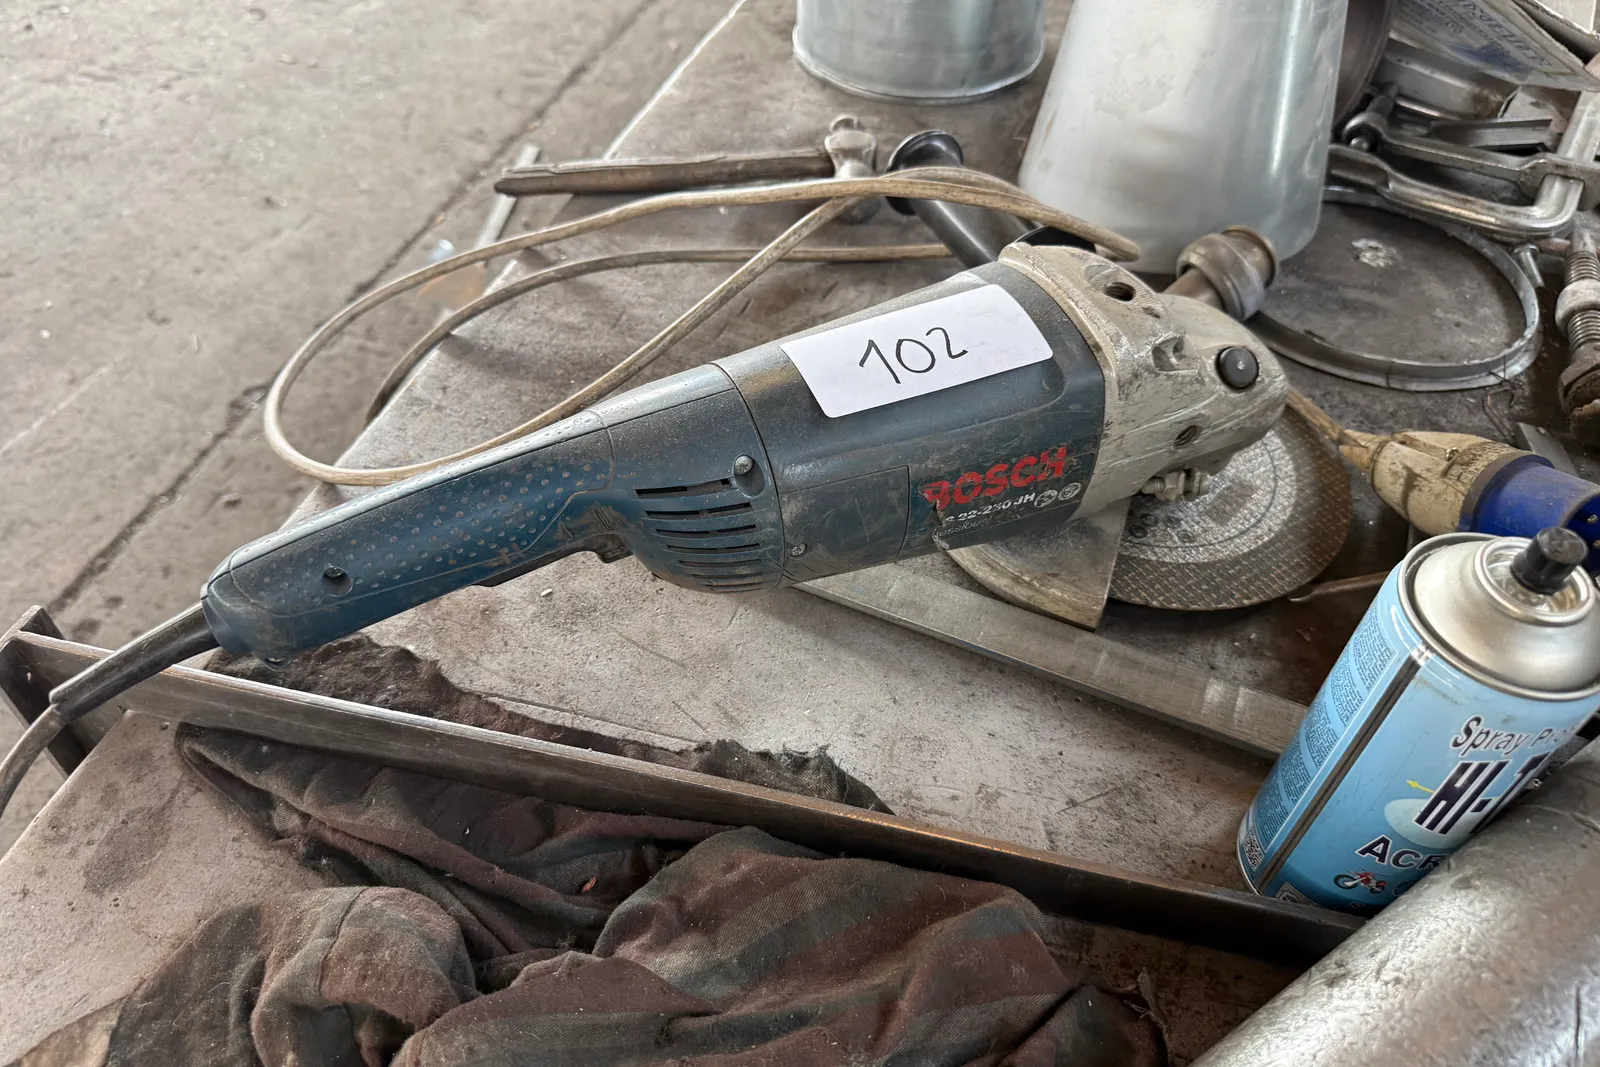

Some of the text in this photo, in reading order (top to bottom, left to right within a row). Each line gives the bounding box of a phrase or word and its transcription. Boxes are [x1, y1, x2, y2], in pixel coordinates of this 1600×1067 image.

[859, 326, 968, 384] 102
[919, 447, 1068, 510] BOSCH
[1450, 714, 1530, 757] Spray
